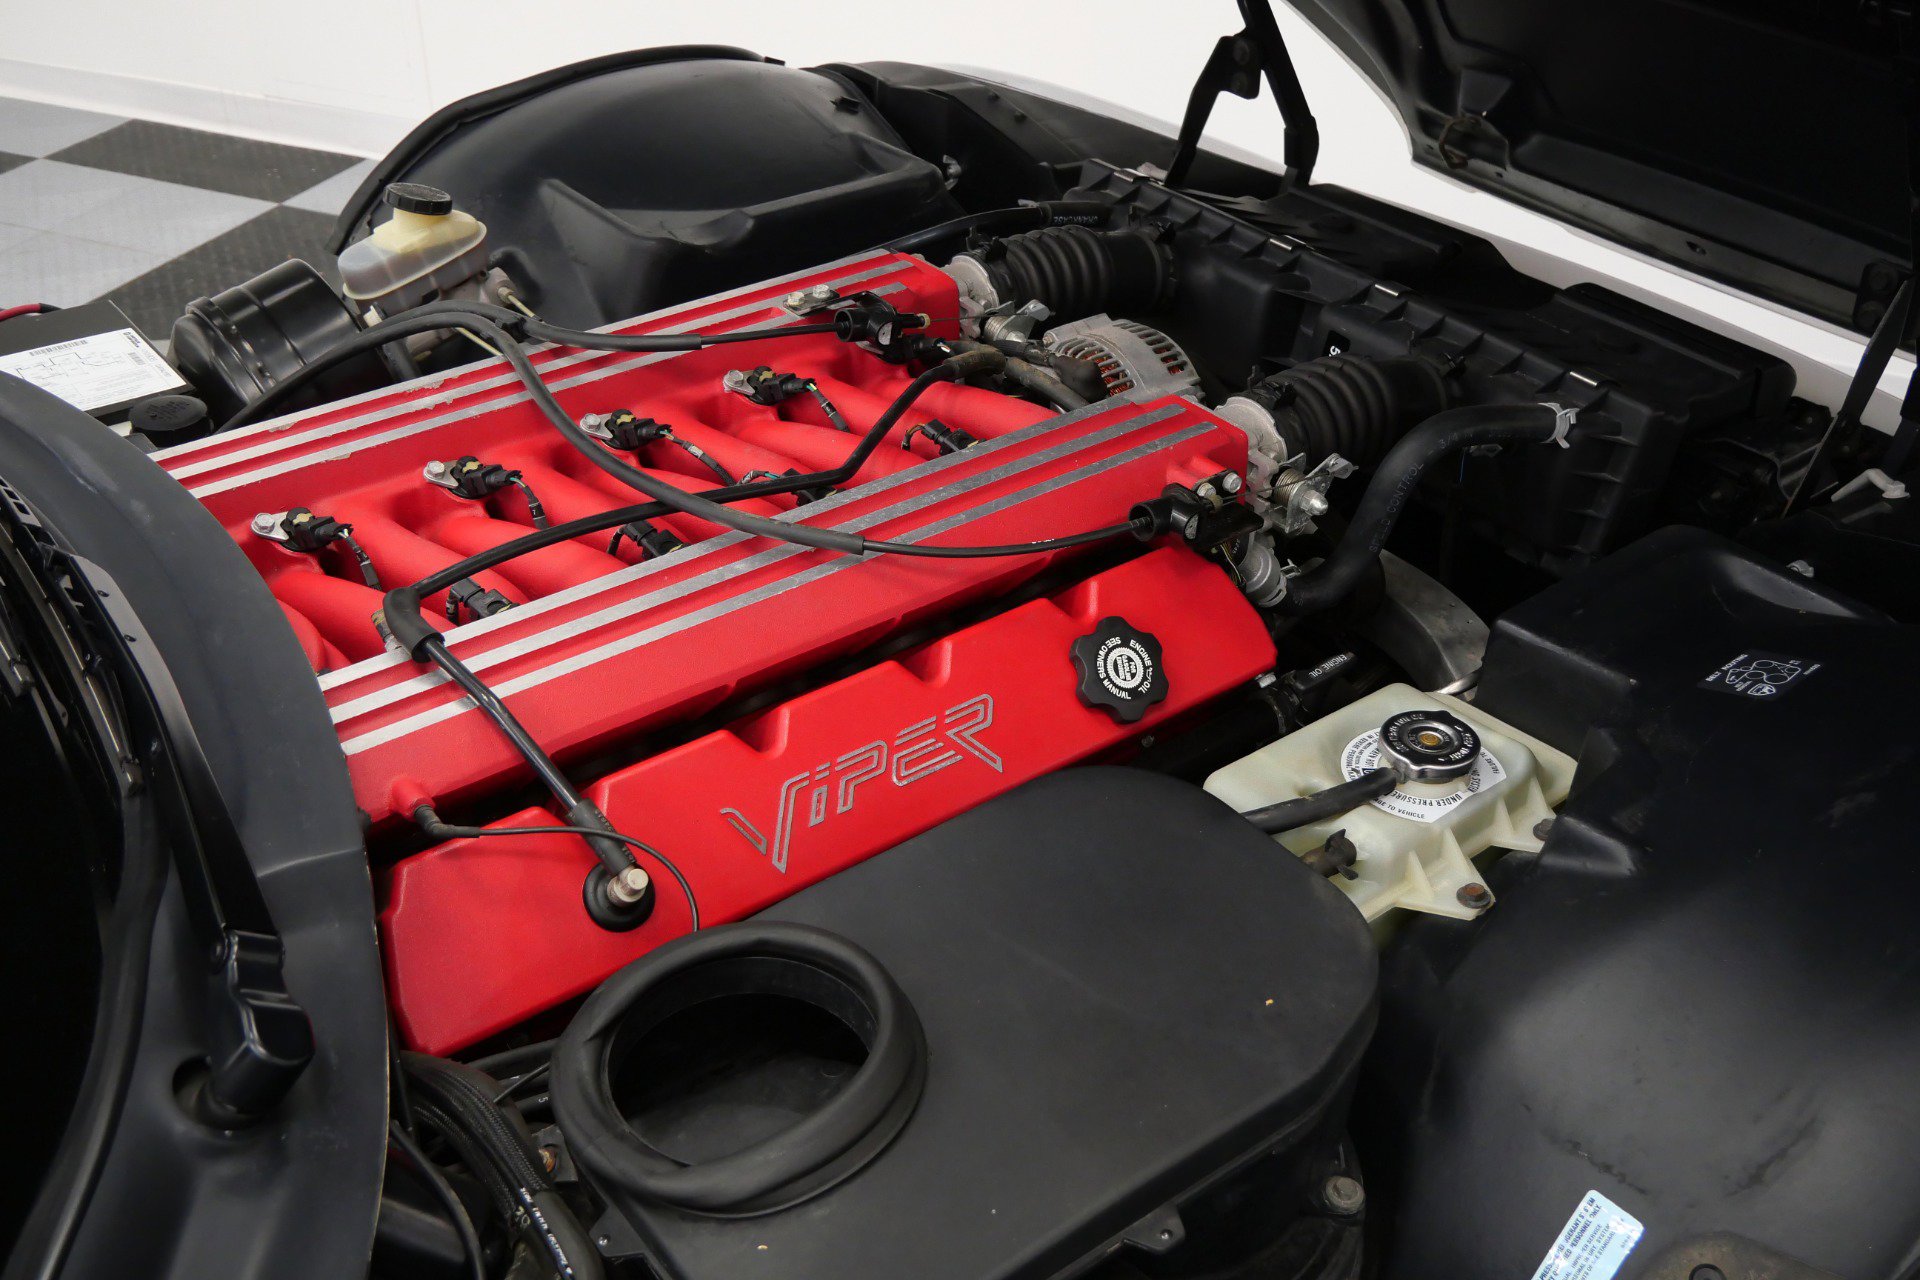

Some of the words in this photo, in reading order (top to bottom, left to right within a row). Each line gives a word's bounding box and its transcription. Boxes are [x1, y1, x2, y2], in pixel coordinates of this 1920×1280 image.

[1105, 636, 1121, 649] SEE
[1129, 639, 1153, 667] ENGINE
[1096, 645, 1109, 679] OWNERS
[1321, 654, 1348, 671] ENGINE
[1309, 668, 1323, 678] OIL
[1102, 679, 1131, 700] MANUAL
[1137, 681, 1151, 694] OIL
[719, 693, 1003, 874] VIPER
[1390, 790, 1434, 807] PRESSURE
[1437, 793, 1463, 807] UNDER
[1398, 808, 1425, 819] VEHICLE
